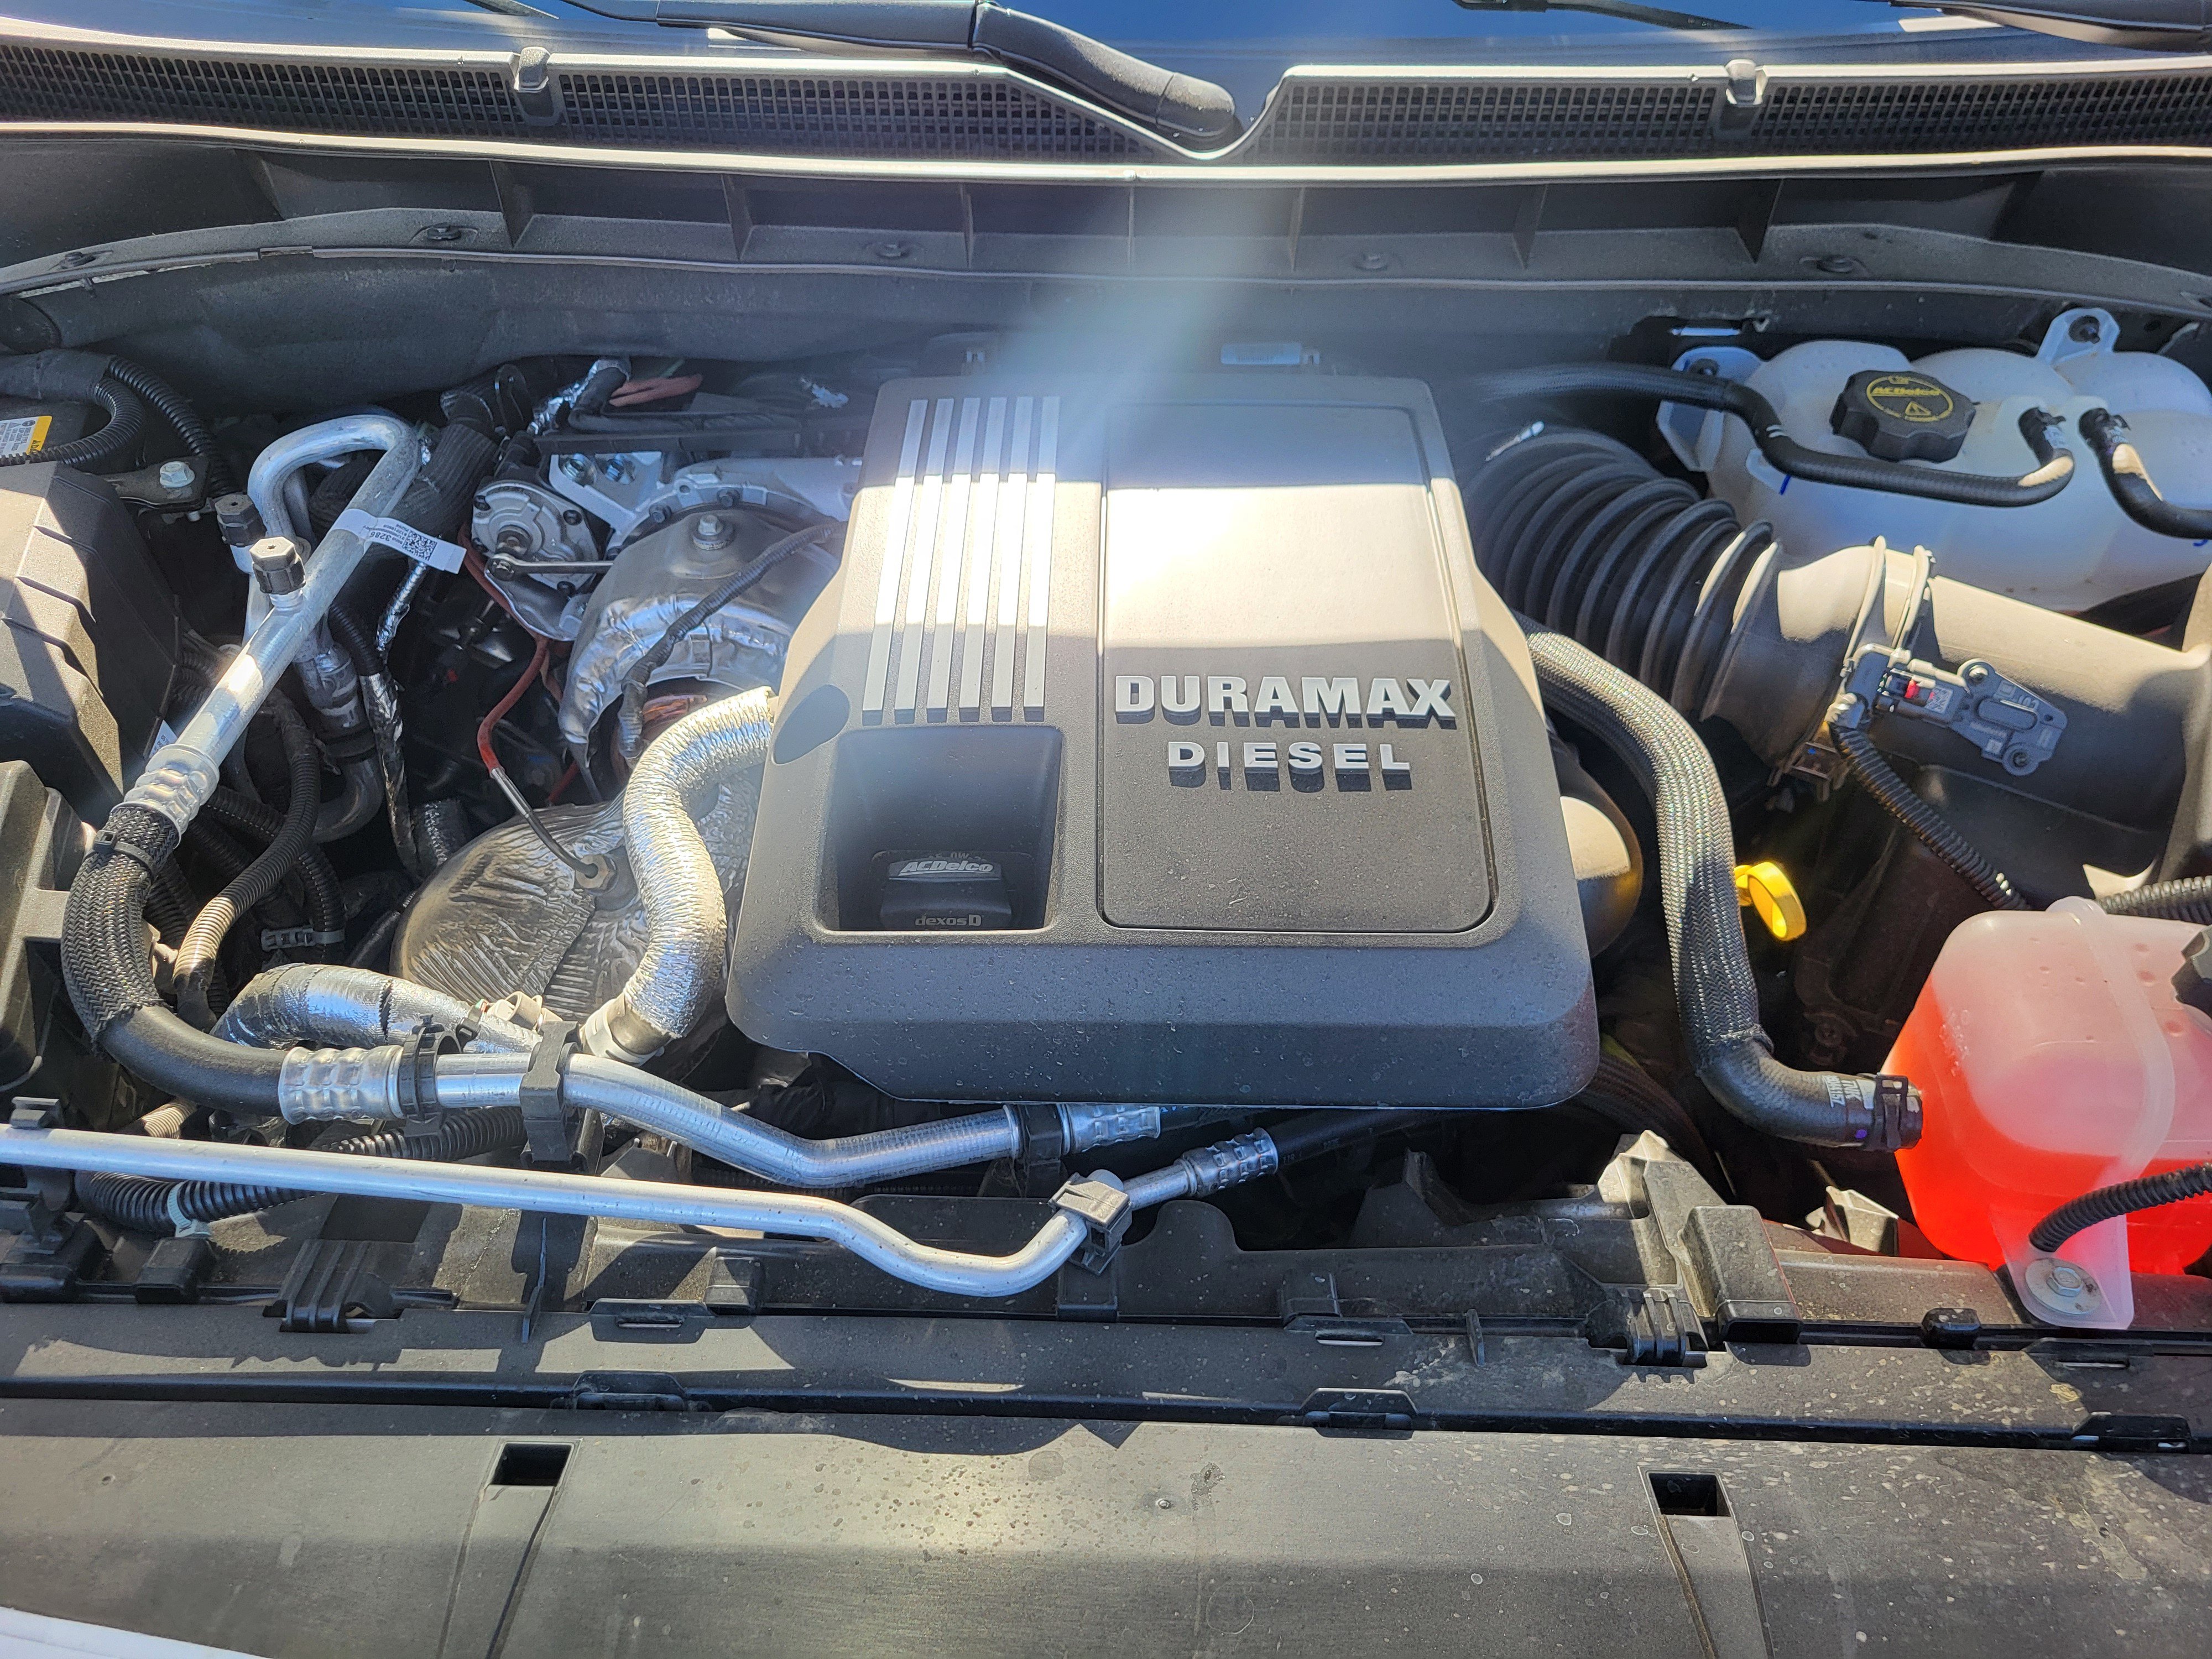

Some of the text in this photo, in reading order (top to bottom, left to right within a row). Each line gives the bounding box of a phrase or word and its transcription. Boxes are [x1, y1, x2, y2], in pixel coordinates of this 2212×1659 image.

[370, 531, 390, 541] 3286
[1115, 675, 1457, 722] DURAMAX
[1167, 741, 1411, 778] DIESEL
[900, 860, 993, 873] ACDelco
